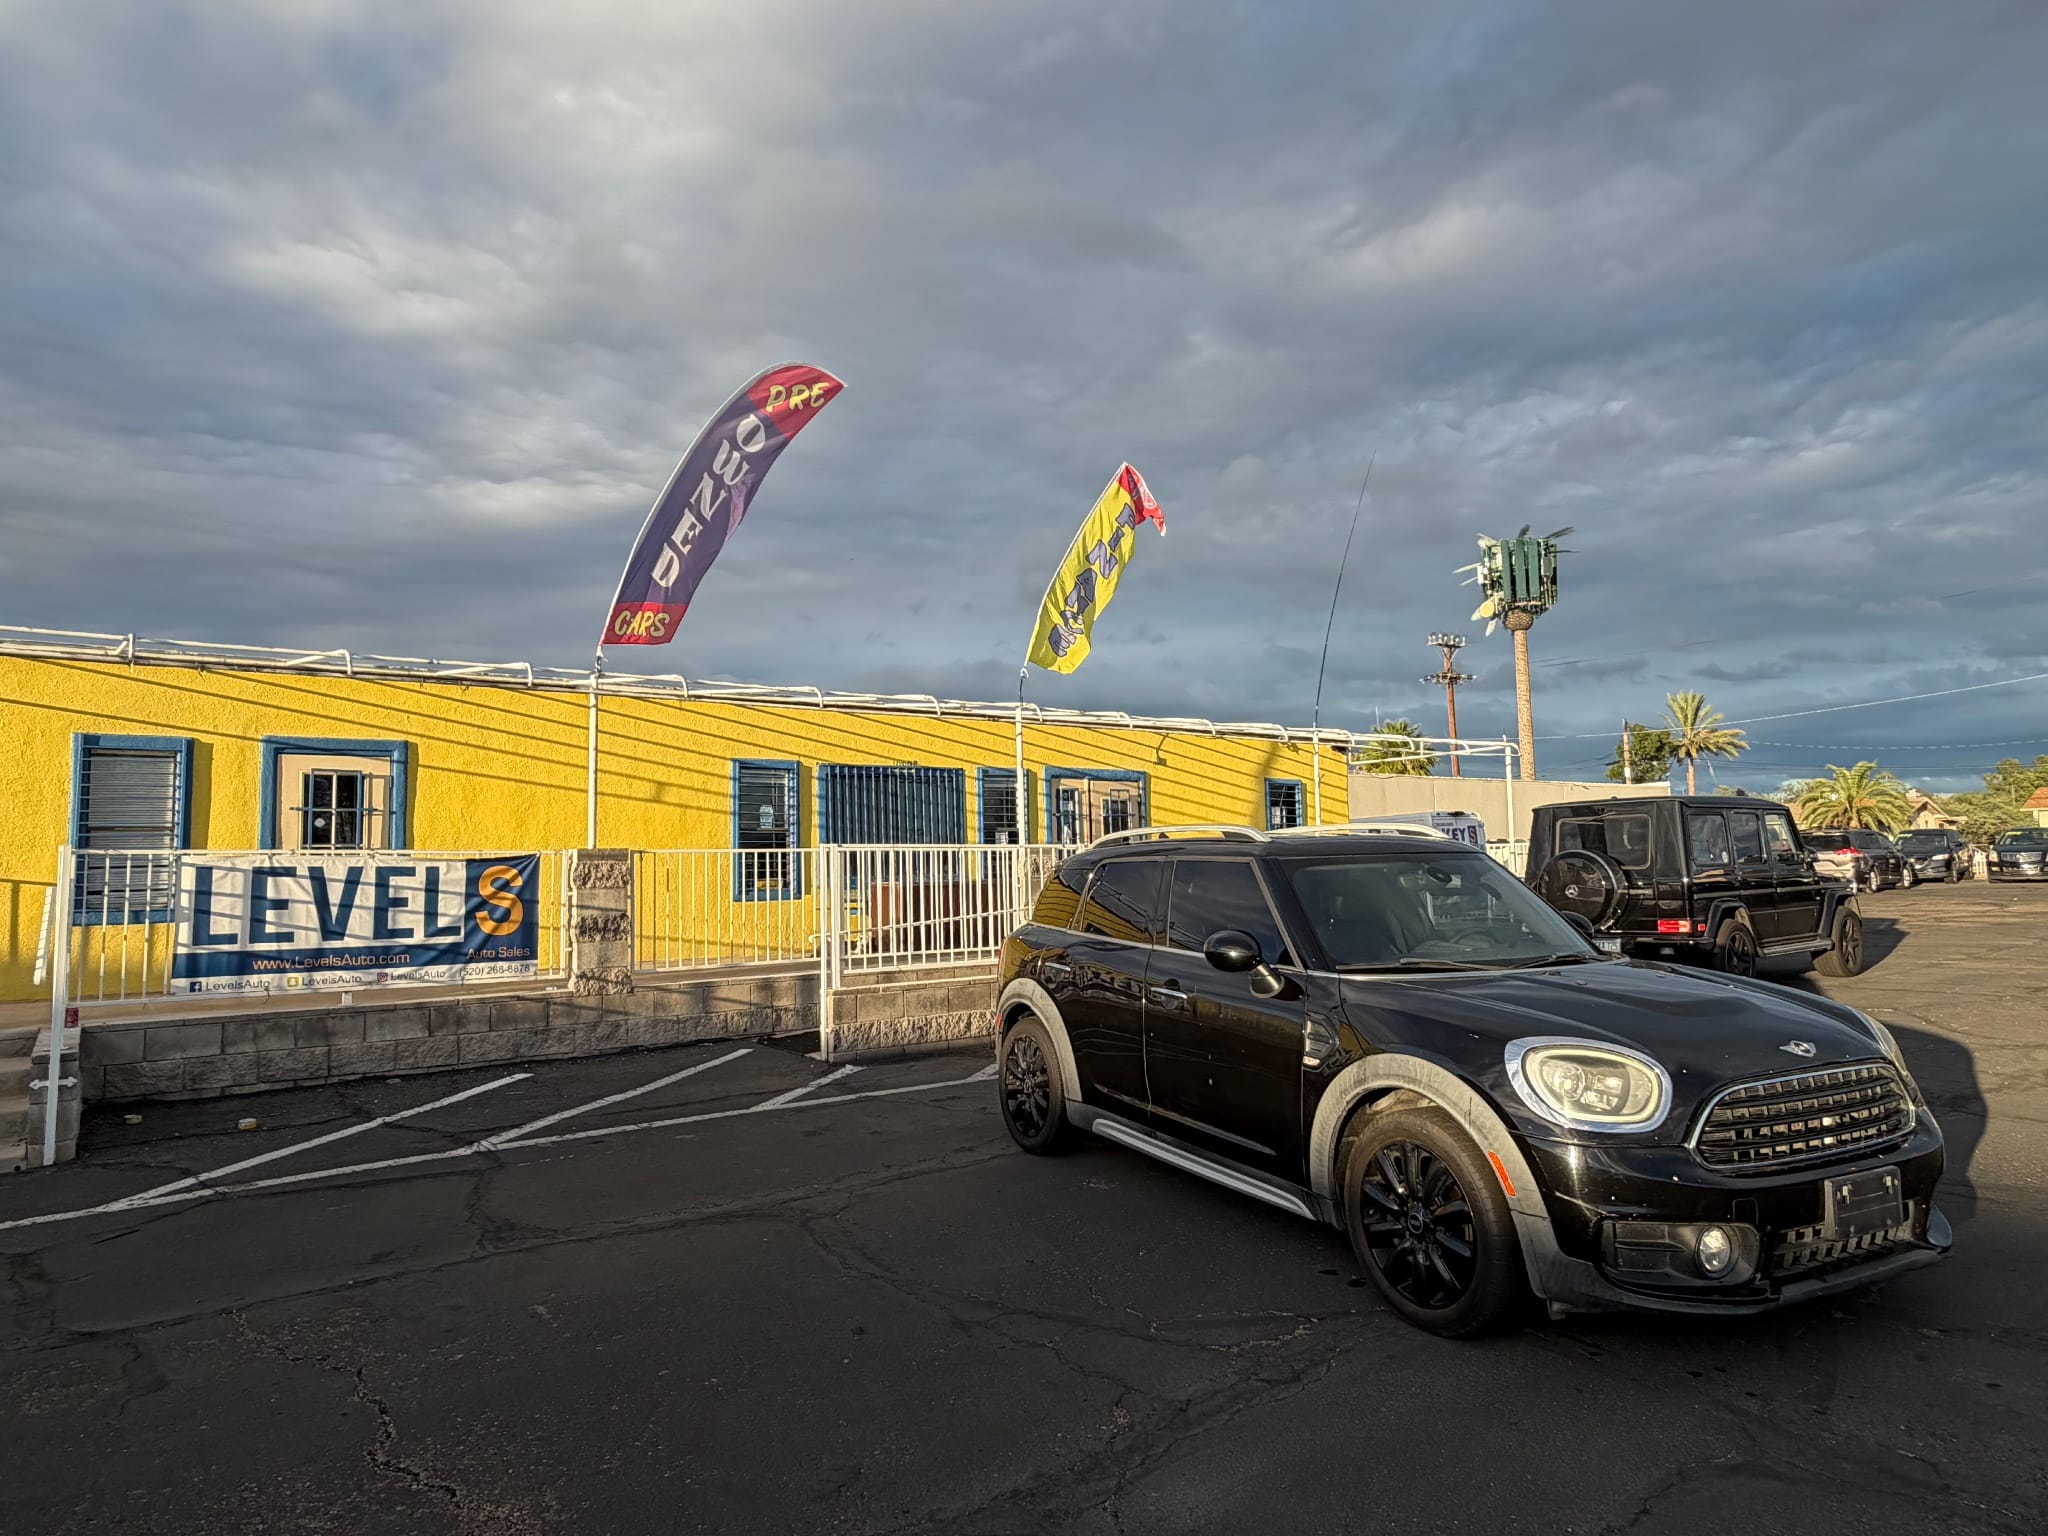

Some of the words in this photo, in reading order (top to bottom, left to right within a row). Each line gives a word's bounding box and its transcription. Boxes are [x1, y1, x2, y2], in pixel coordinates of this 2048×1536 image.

[765, 382, 830, 413] PRE
[651, 414, 766, 587] OWNED
[1048, 502, 1136, 657] FINANCE
[614, 610, 670, 637] CARS
[192, 865, 524, 947] LEVELS
[466, 948, 495, 959] Auto
[498, 946, 530, 958] Sales
[252, 953, 410, 970] www.LevelsAuto.com
[302, 974, 362, 985] LevelsAuto
[390, 969, 446, 981] LevelsAuto
[460, 967, 484, 976] (520)
[206, 979, 270, 991] LevelsAuto
